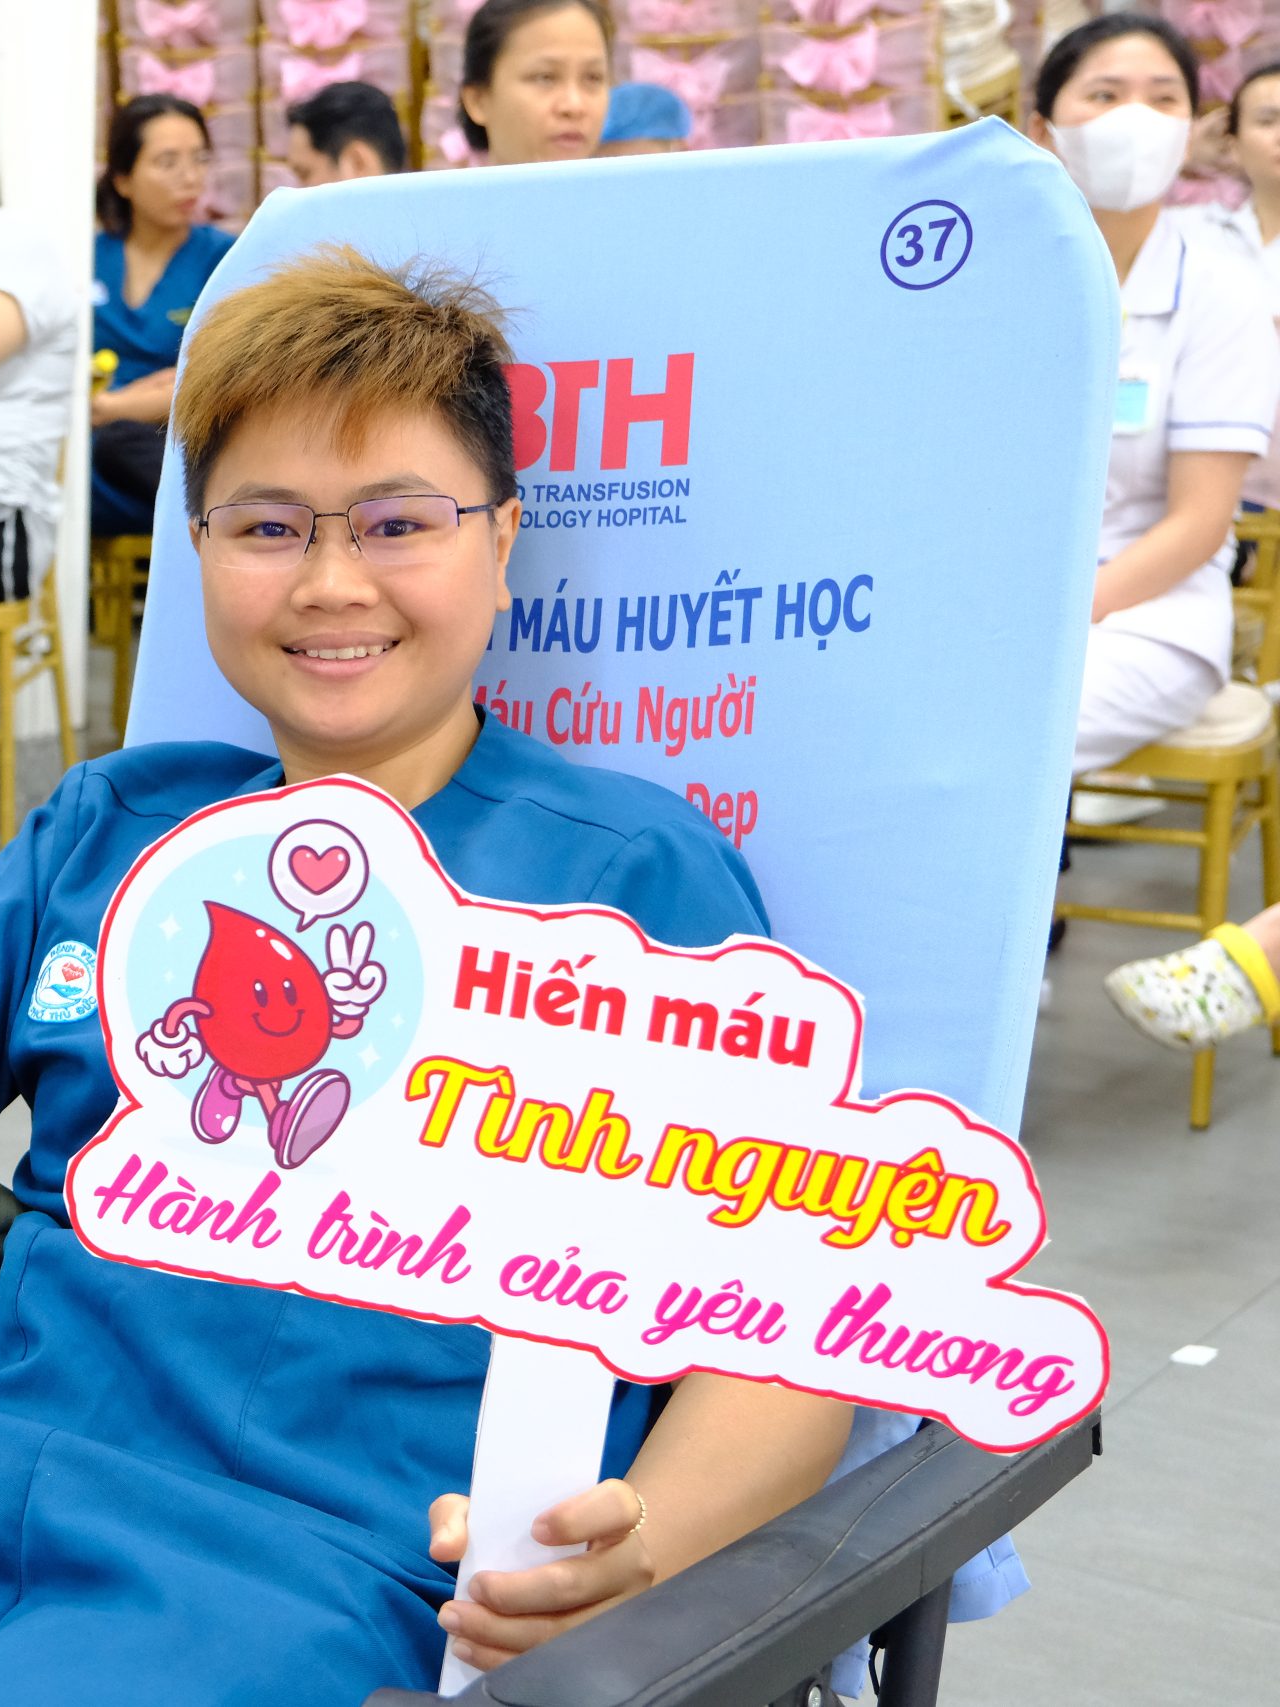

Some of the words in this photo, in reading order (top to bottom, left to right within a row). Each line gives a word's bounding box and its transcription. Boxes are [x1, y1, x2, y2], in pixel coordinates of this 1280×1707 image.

[895, 217, 957, 267] 37
[519, 508, 592, 529] OLOGY
[597, 505, 687, 528] HOPITAL
[533, 478, 690, 503] TRANSFUSION
[508, 578, 602, 654] MÁU
[615, 568, 763, 653] HUYẾT
[774, 574, 873, 651] HỌC
[545, 681, 622, 746] Cứu
[635, 673, 757, 757] Người
[453, 945, 627, 1036] Hiến
[647, 991, 816, 1068] máu
[405, 1055, 642, 1179] Tình
[646, 1123, 1012, 1248] nguyện
[94, 1153, 282, 1249] Hành
[306, 1190, 472, 1284] trình
[499, 1246, 628, 1315] của
[640, 1279, 787, 1345] yêu
[814, 1282, 1075, 1417] thương
